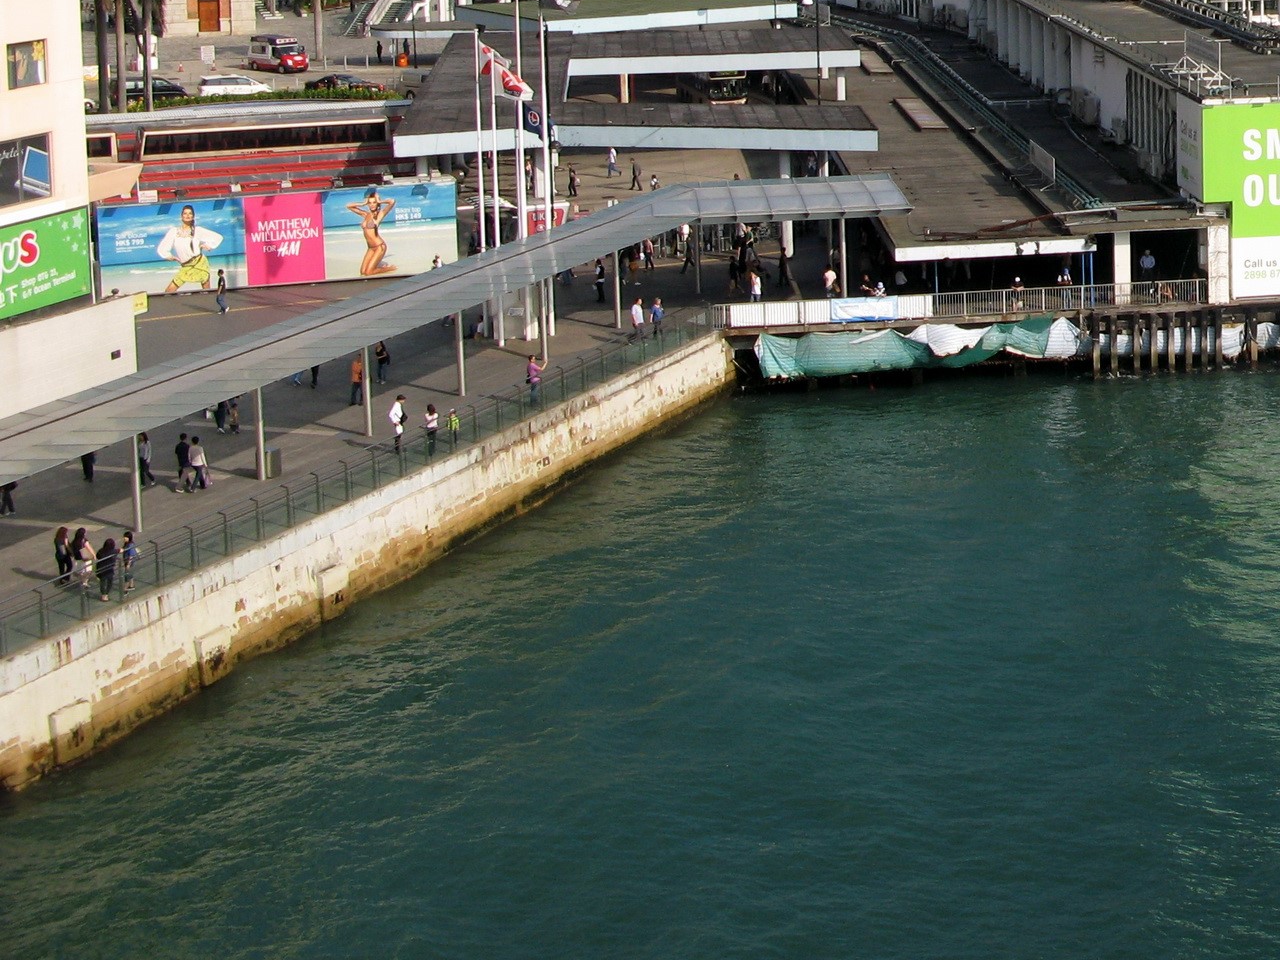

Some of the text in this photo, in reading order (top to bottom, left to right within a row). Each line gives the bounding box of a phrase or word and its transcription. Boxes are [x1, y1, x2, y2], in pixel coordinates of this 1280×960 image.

[257, 217, 311, 232] MATTHEW
[250, 226, 319, 243] WILLIAMSON
[263, 240, 302, 257] FOR H&M
[1244, 258, 1263, 269] Call
[1265, 259, 1278, 268] us
[33, 282, 52, 294] Ocean
[52, 269, 76, 286] Terminal
[1244, 270, 1267, 280] 2898
